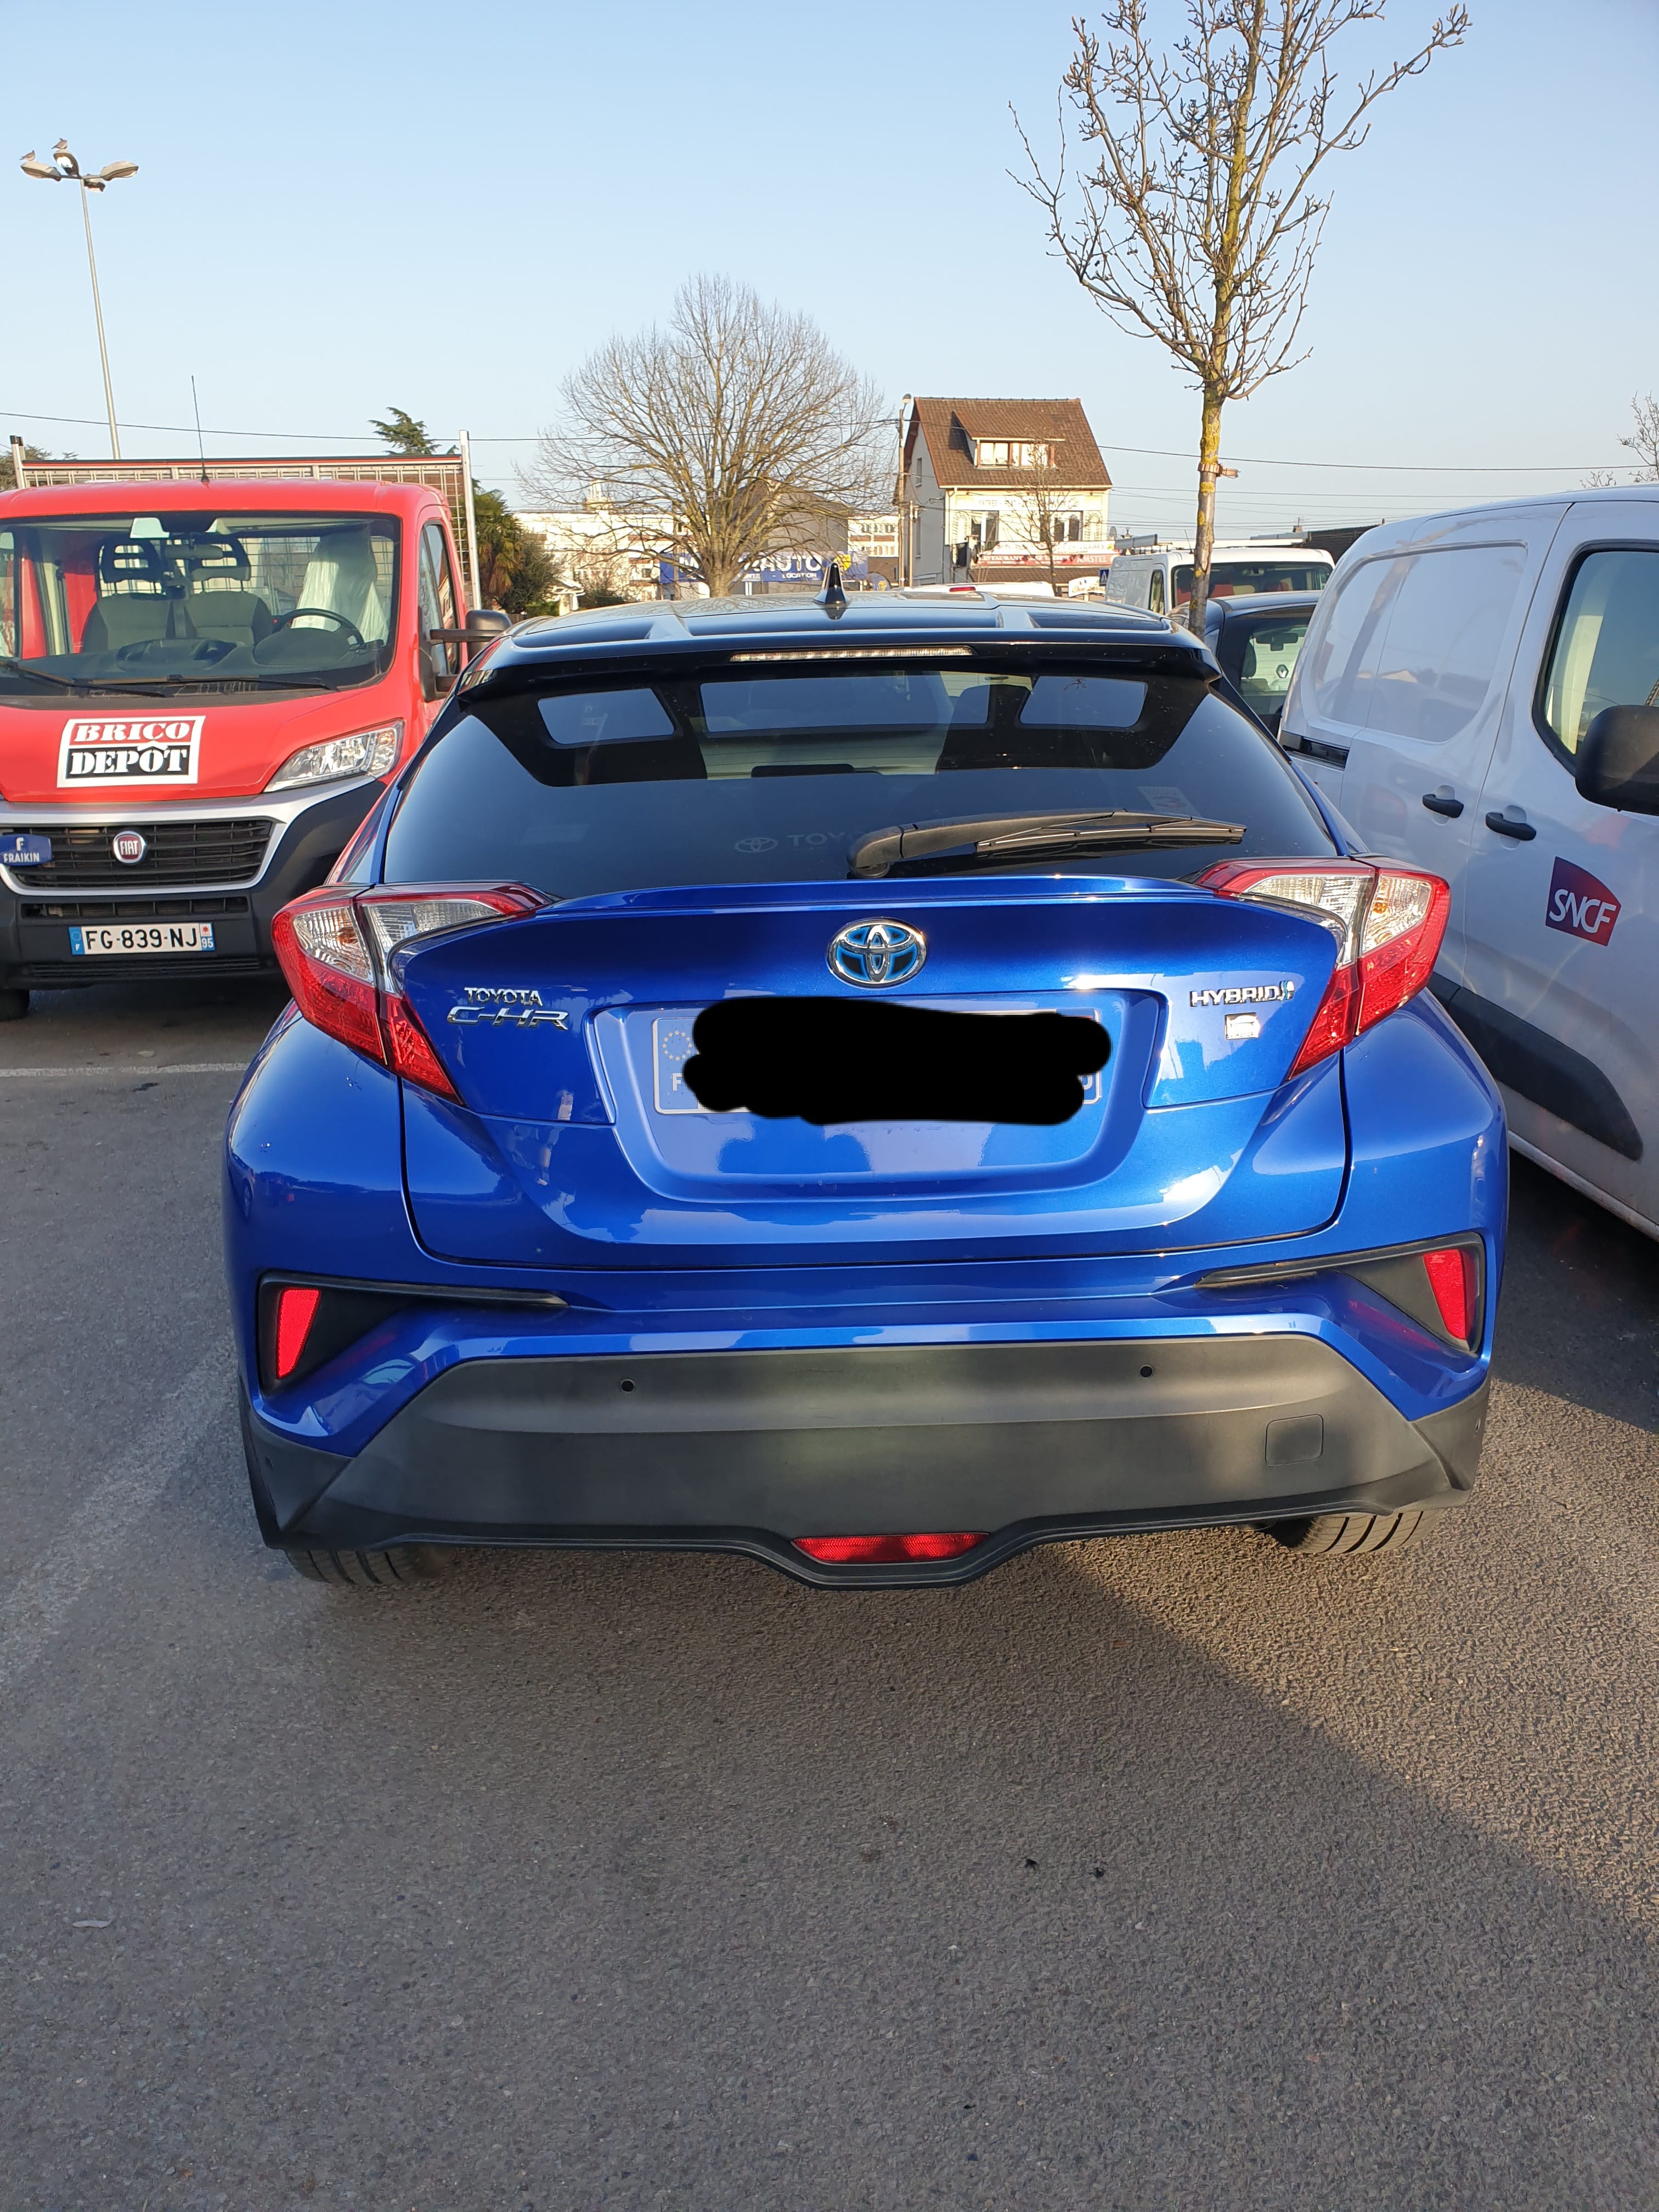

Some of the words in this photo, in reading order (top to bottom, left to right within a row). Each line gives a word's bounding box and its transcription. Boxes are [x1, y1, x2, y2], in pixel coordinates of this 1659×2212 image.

[1076, 555, 1107, 563] AMSTEL
[74, 722, 190, 742] BRICO
[70, 741, 187, 775] DEPÔT
[16, 837, 24, 851] F
[120, 840, 138, 855] FIAT
[3, 852, 40, 863] FRAIKIN
[1549, 889, 1617, 934] SNCF
[85, 928, 198, 950] FG-839-NJ
[201, 938, 214, 949] 95
[464, 987, 543, 1006] TOYOTA
[1190, 985, 1280, 1007] HYBRID
[447, 1006, 569, 1030] C-HR
[672, 1072, 682, 1091] F
